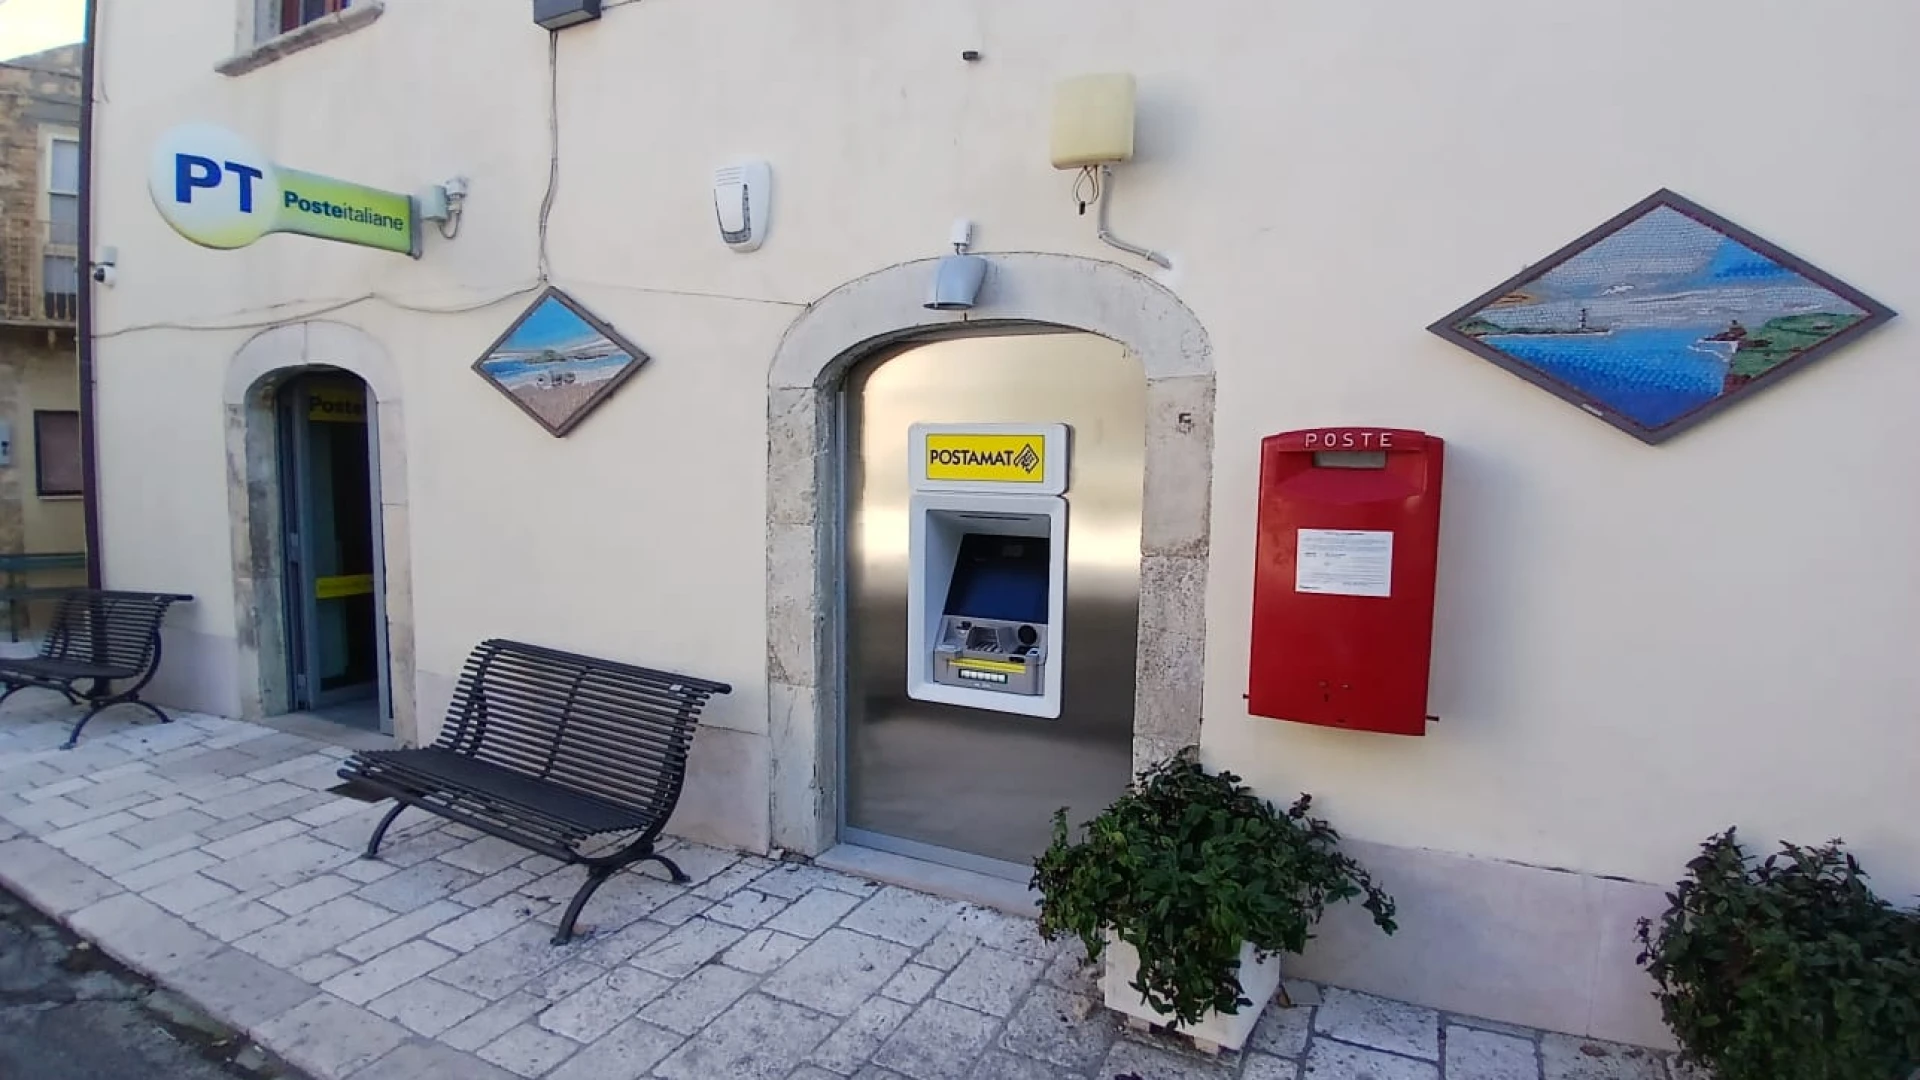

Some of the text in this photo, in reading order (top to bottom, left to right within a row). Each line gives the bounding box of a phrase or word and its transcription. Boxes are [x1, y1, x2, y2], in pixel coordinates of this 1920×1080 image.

[175, 152, 263, 214] PT
[284, 190, 404, 231] Posteitaliane
[1305, 432, 1392, 448] POSTE
[929, 448, 1015, 466] POSTAMAT
